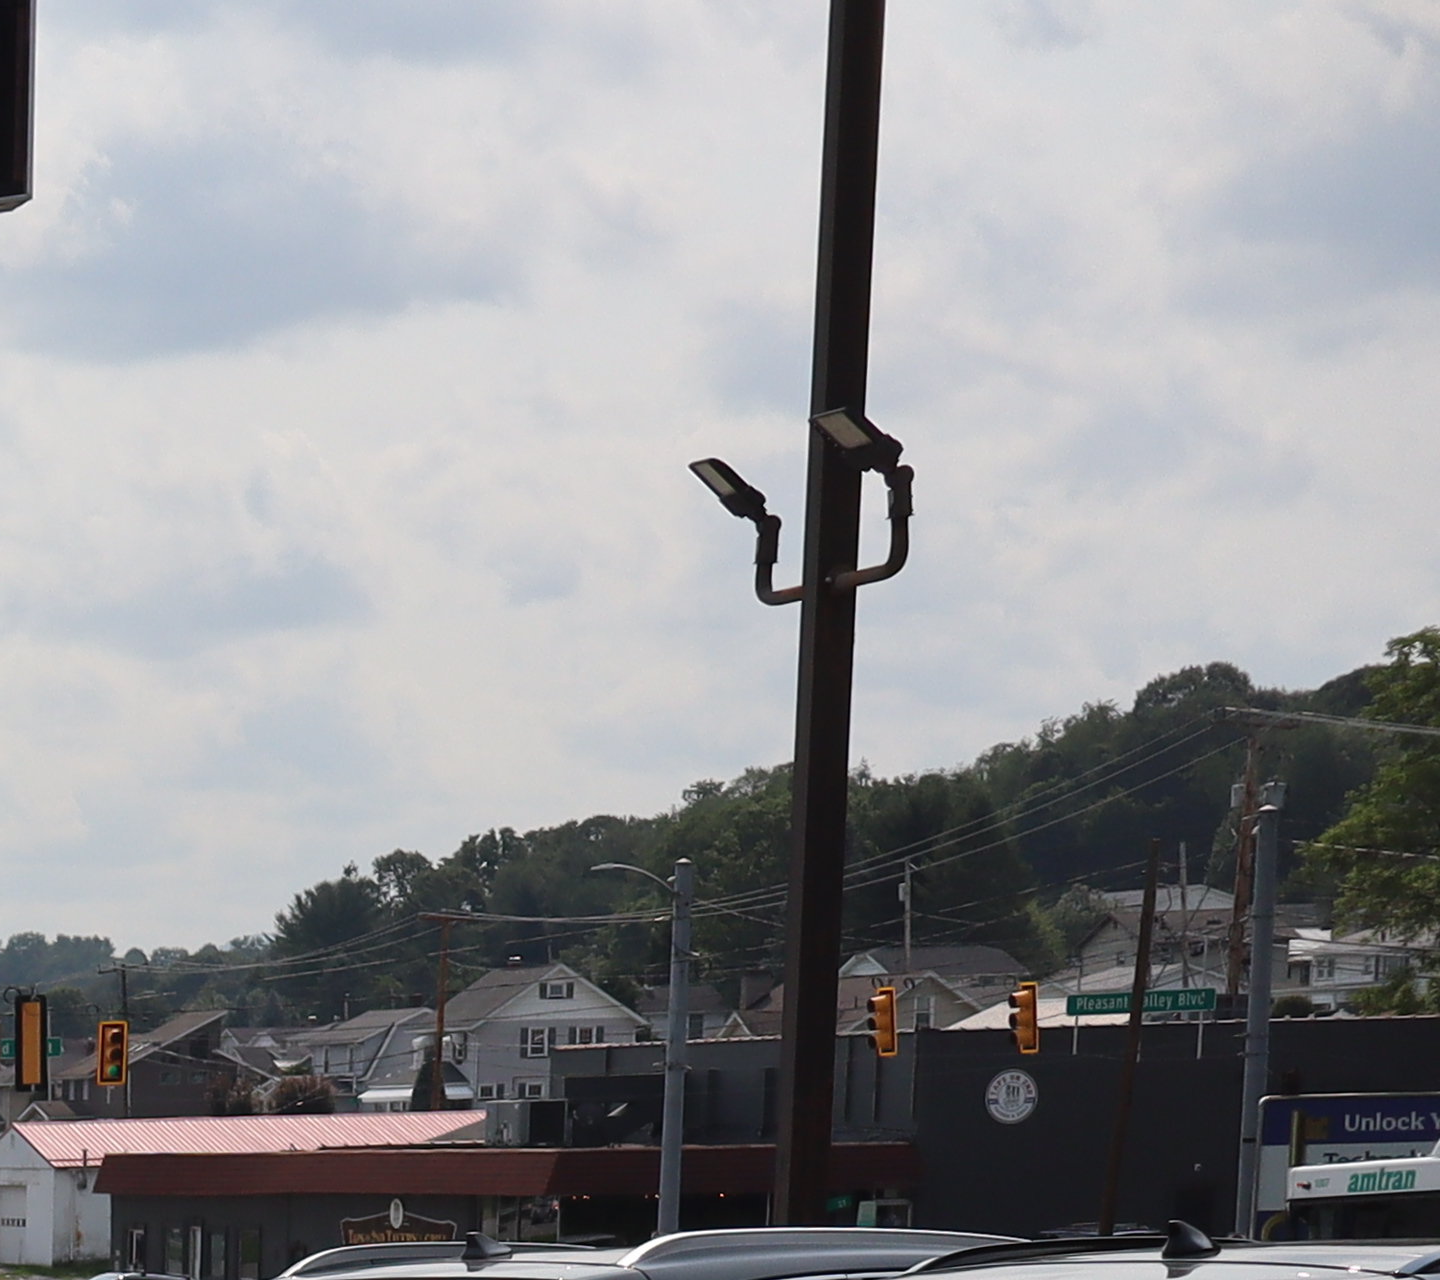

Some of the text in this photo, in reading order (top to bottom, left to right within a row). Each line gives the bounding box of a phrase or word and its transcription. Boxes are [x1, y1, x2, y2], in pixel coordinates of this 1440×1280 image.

[1076, 992, 1206, 1011] Pleasant alley Blvd
[1344, 1111, 1425, 1132] Unlock
[1347, 1167, 1417, 1193] amtran
